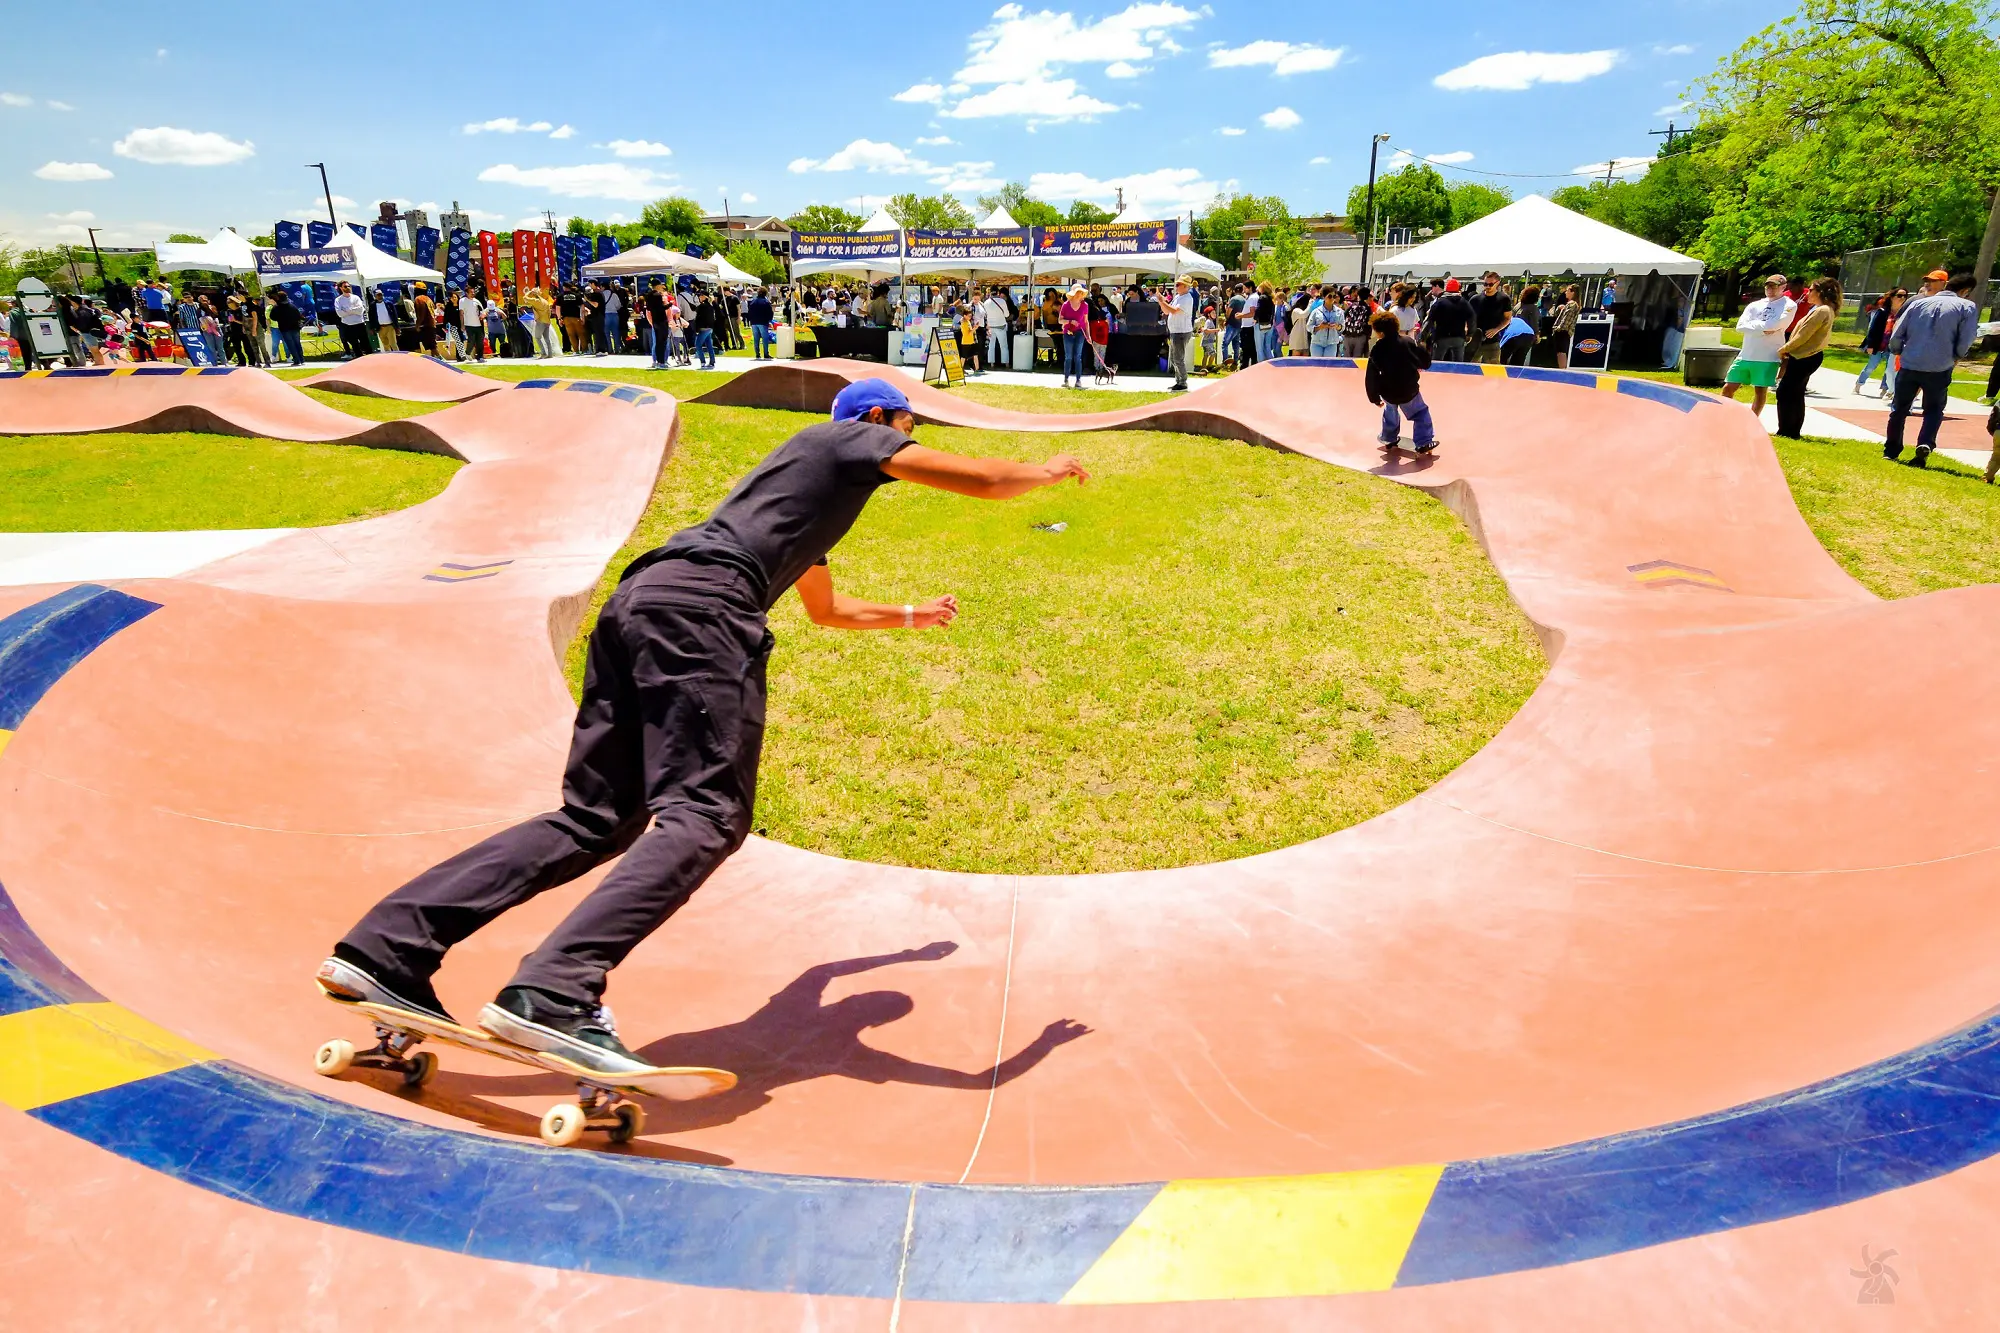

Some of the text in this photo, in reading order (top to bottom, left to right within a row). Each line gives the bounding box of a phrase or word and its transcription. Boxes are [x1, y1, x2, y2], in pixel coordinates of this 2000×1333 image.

[1061, 224, 1090, 232] STATION
[1092, 222, 1136, 230] COMMUNITY
[870, 234, 893, 242] LIBRARY
[796, 244, 899, 255] SIGN UP FOR A LIBRARY CARD
[910, 245, 1027, 257] SKATE SCHOOL REGISTRATION
[1070, 240, 1138, 252] FACE PAINTING
[280, 253, 339, 265] LEARN TO SKATE
[543, 237, 551, 276] FIRE
[521, 234, 530, 294] STATIO
